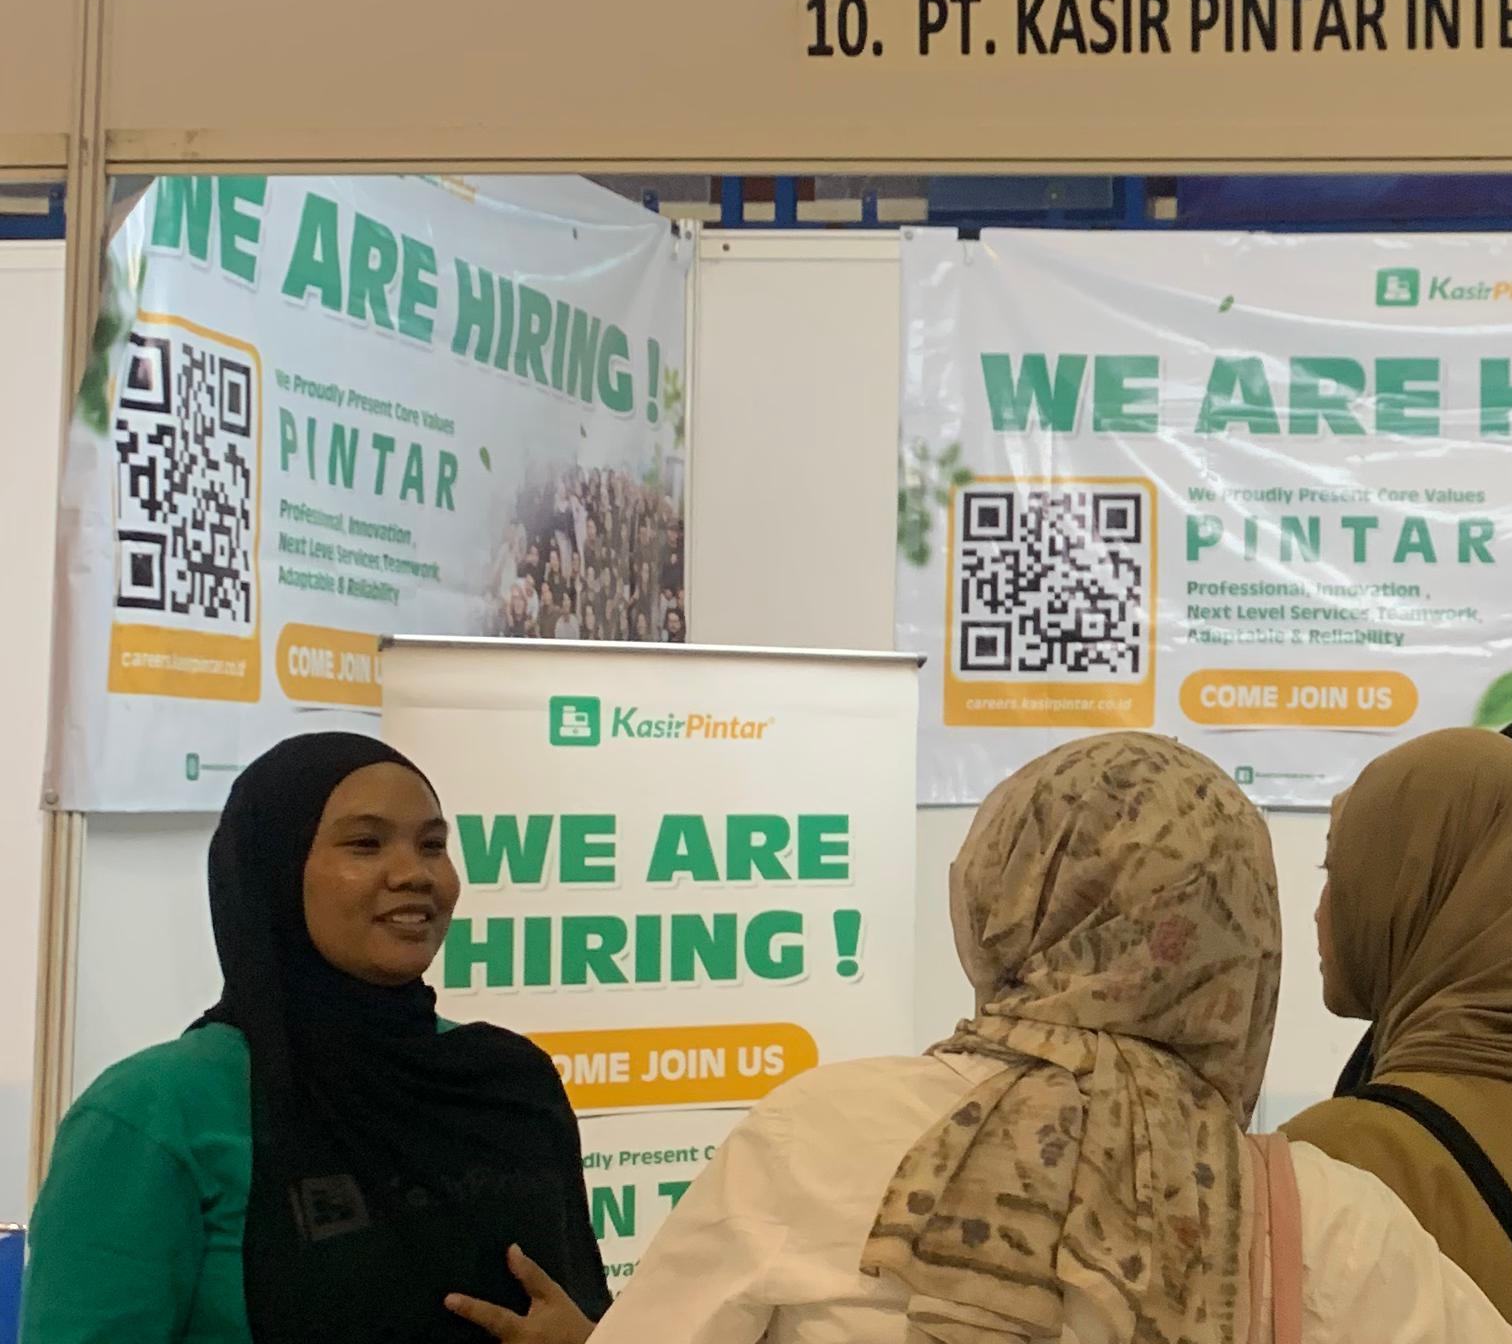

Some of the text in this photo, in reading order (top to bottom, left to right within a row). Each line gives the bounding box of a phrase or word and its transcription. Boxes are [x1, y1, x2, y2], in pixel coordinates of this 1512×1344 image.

[282, 191, 438, 343] ARE
[450, 257, 634, 413] HIRING
[294, 375, 345, 407] Proudly
[348, 390, 393, 418] Present
[981, 352, 1160, 433] WE
[1194, 355, 1441, 437] ARE
[279, 407, 458, 511] PINTAR
[1188, 488, 1216, 503] We
[1377, 488, 1419, 503] Core
[1425, 488, 1486, 503] Values
[279, 531, 306, 556] Next
[1186, 514, 1496, 564] PINTAR
[1187, 605, 1232, 620] Next
[1237, 605, 1285, 620] Level
[1308, 629, 1404, 646] Reliability
[288, 645, 335, 679] COME
[1200, 684, 1393, 711] COME JOIN US
[457, 813, 850, 885] WE ARE
[444, 909, 863, 989] HIRING !
[554, 1044, 785, 1086] OME JOIN US
[619, 1145, 699, 1167] Present
